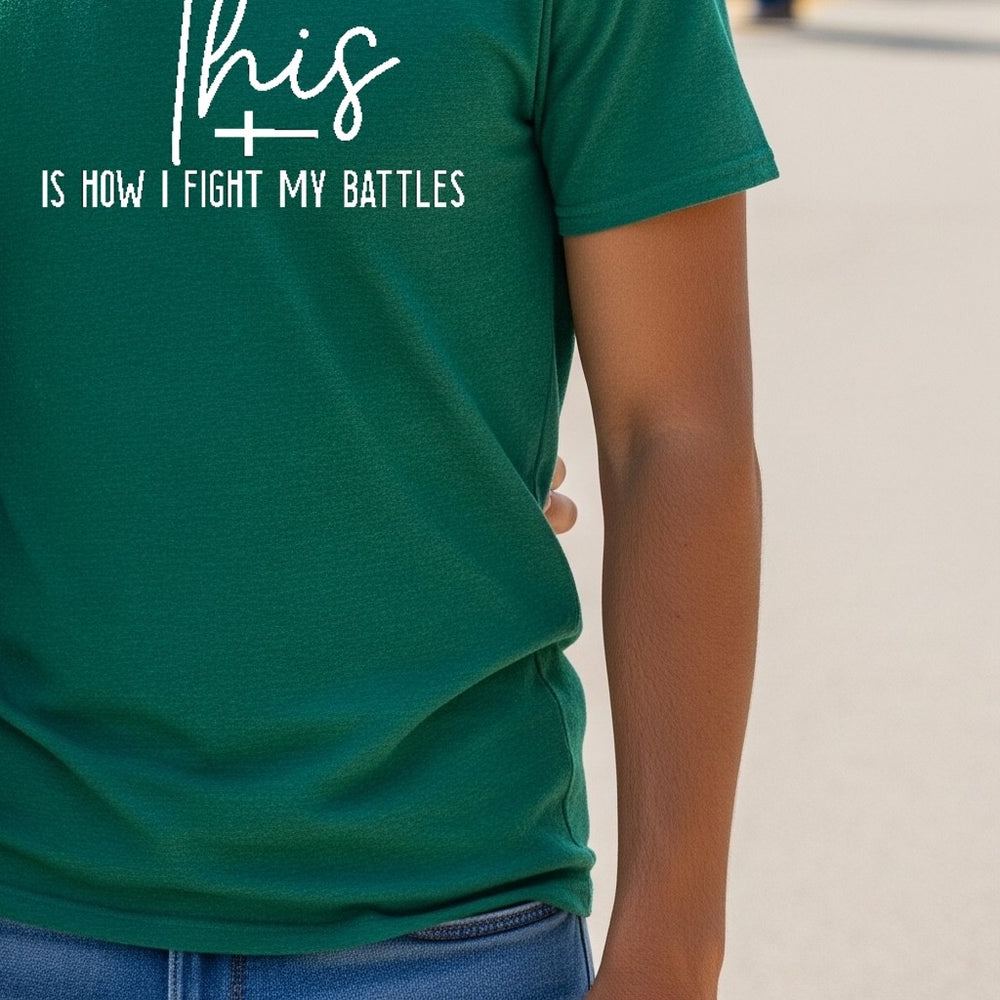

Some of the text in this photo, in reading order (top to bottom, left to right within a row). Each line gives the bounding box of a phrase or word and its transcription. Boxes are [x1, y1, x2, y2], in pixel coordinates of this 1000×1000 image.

[42, 169, 465, 208] IS HOW I FIGHT MY BATTLES
